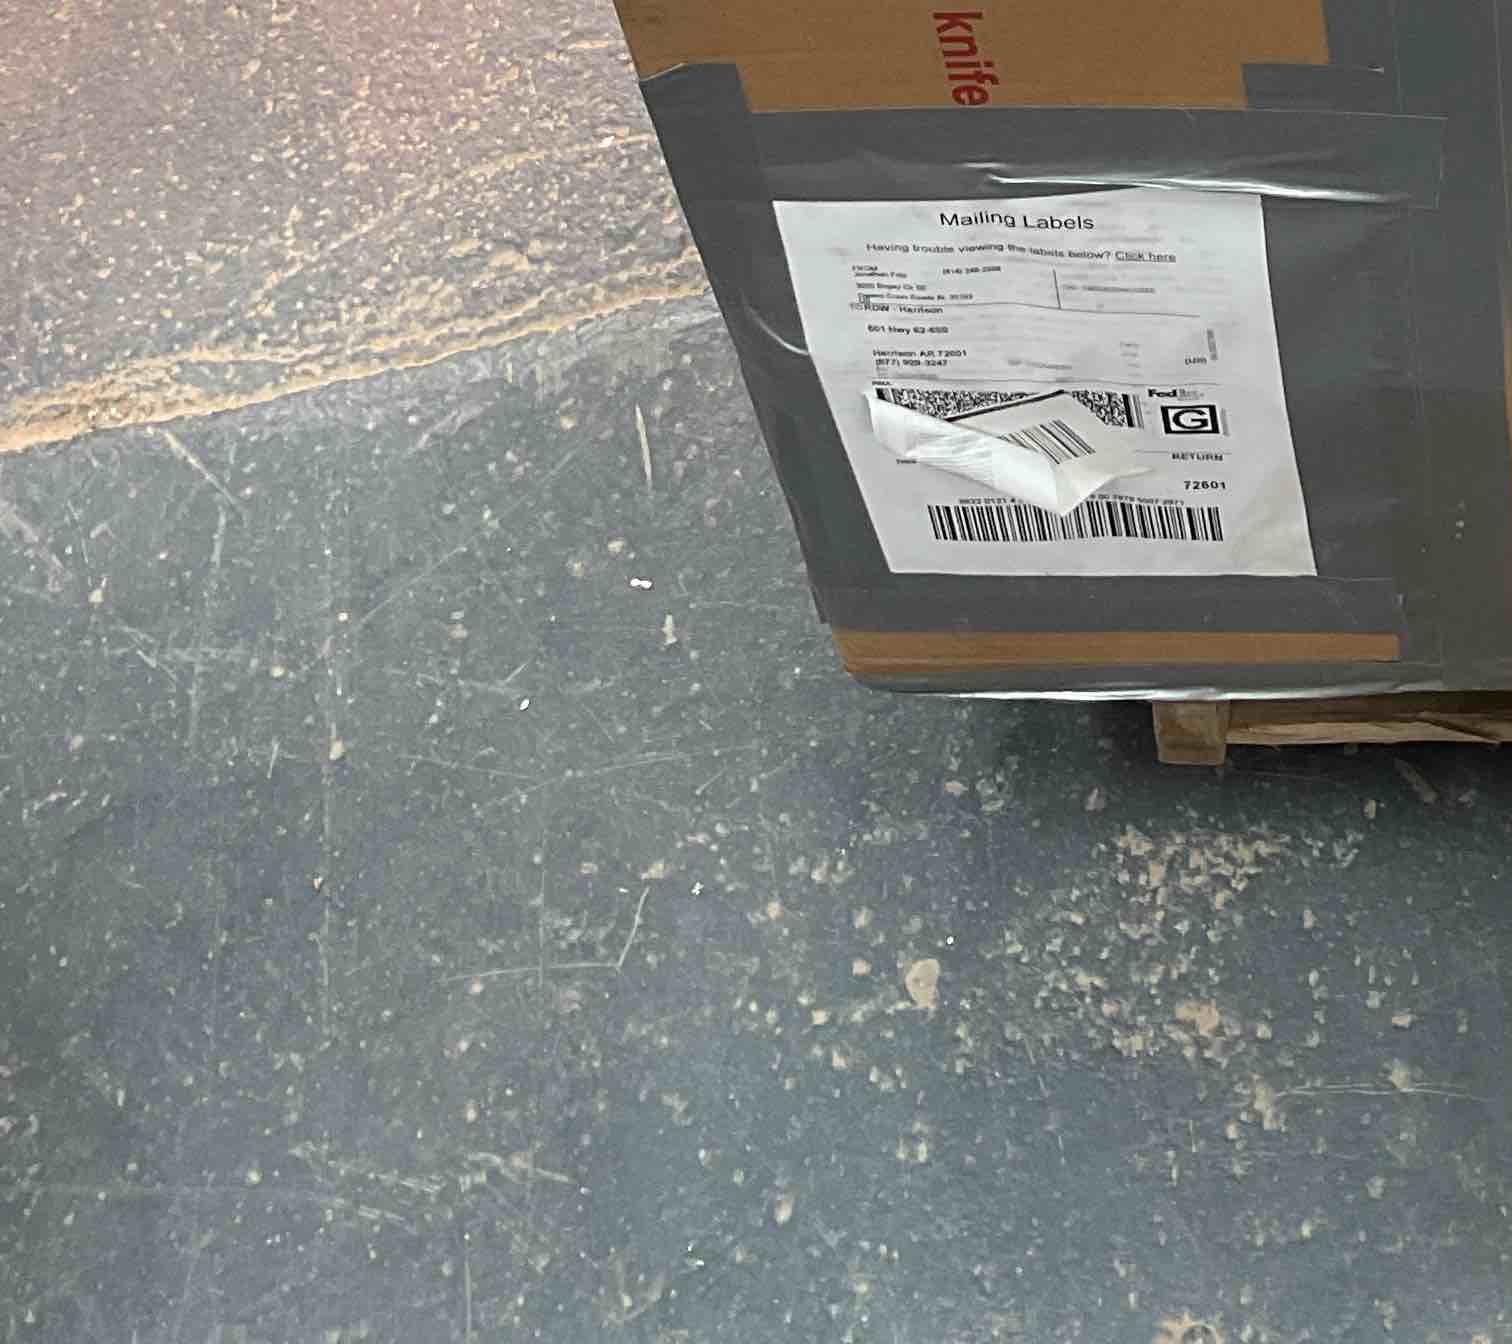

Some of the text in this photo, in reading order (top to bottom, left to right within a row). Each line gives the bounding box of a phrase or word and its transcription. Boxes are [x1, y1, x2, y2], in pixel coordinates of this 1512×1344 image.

[933, 11, 999, 106] knife
[939, 210, 1096, 231] Mailing Labels
[866, 242, 910, 254] Having
[912, 243, 955, 254] trouble
[957, 242, 1005, 254] viewing
[1068, 248, 1112, 260] below?
[1114, 250, 1145, 262] Click
[1148, 251, 1177, 263] here
[1172, 409, 1210, 430] G
[1171, 452, 1224, 462] RETURN
[1183, 480, 1227, 491] 72601
